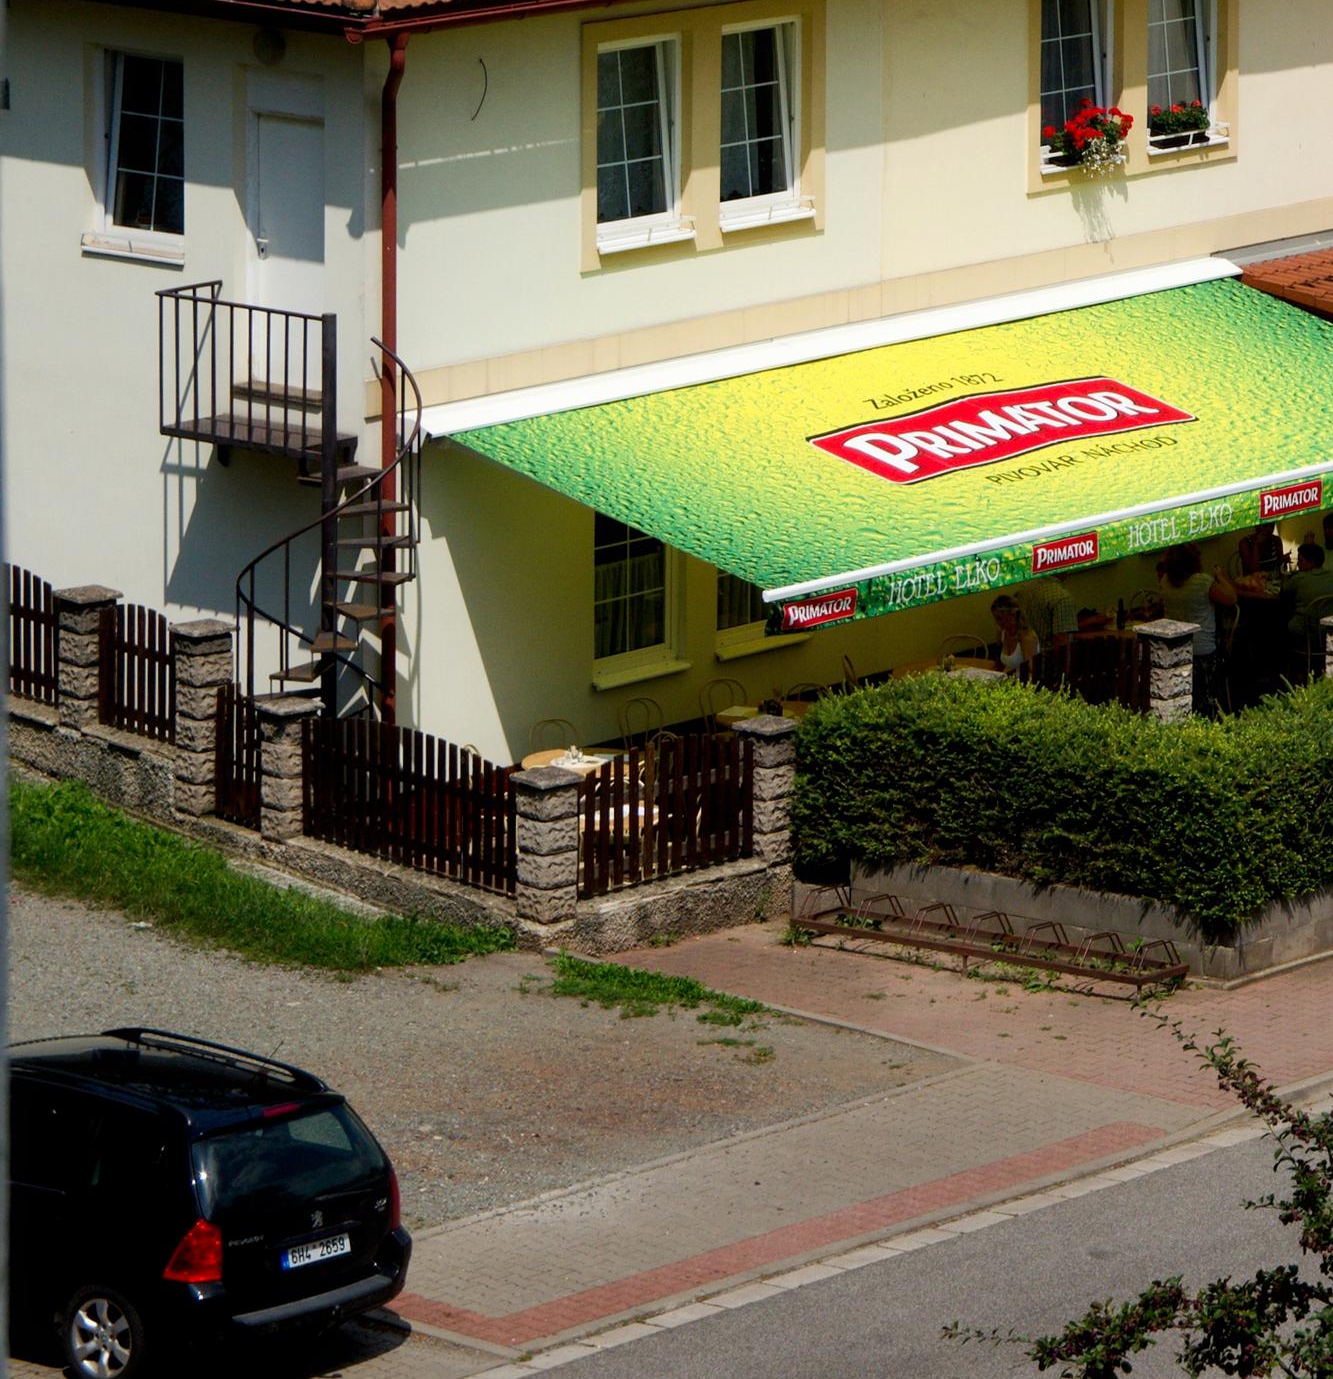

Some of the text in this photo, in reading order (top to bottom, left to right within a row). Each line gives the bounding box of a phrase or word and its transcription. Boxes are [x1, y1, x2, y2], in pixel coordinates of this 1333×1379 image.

[863, 372, 1005, 410] Založeno 1872
[985, 435, 1179, 486] PIVOVAR NÁCHOD
[1127, 503, 1234, 549] HOTEL ELKO
[887, 557, 1001, 606] HOTEL ELKO
[291, 1236, 346, 1264] 6H4 2659
